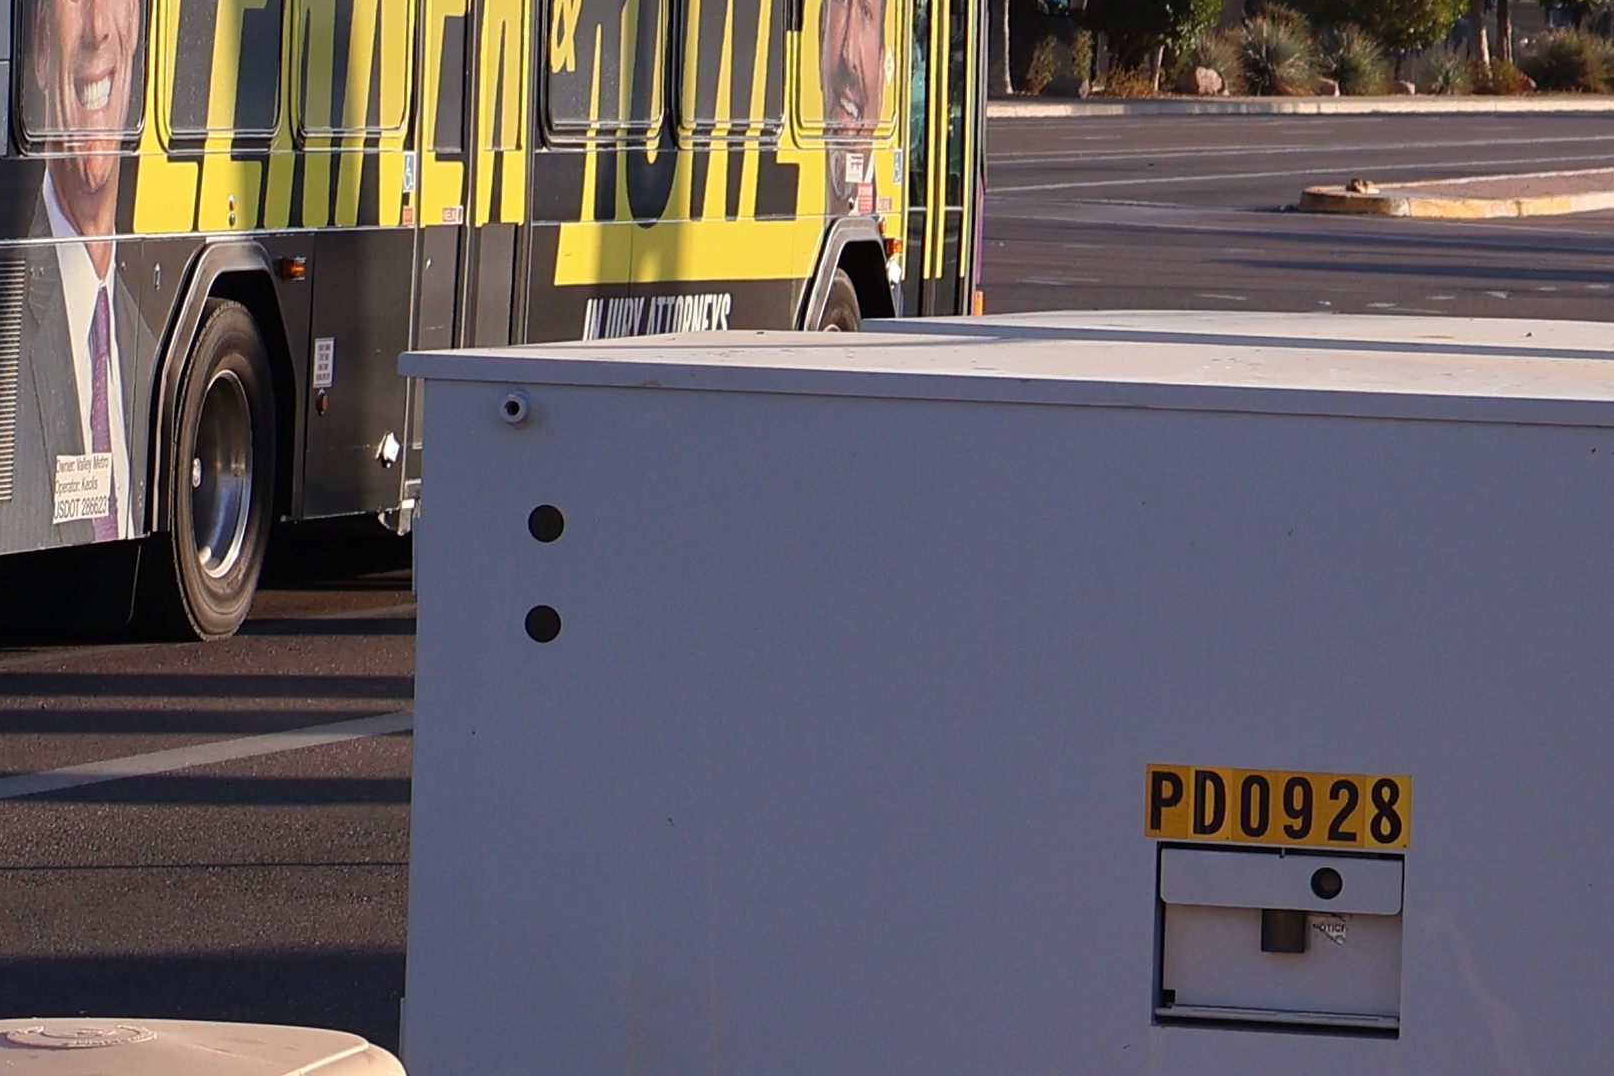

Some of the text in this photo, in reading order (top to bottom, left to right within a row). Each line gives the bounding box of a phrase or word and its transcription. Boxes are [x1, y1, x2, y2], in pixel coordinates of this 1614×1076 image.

[646, 292, 731, 336] ATTORNEYS
[76, 456, 92, 474] Valley
[93, 455, 109, 469] Metro
[1150, 769, 1403, 844] PD0928
